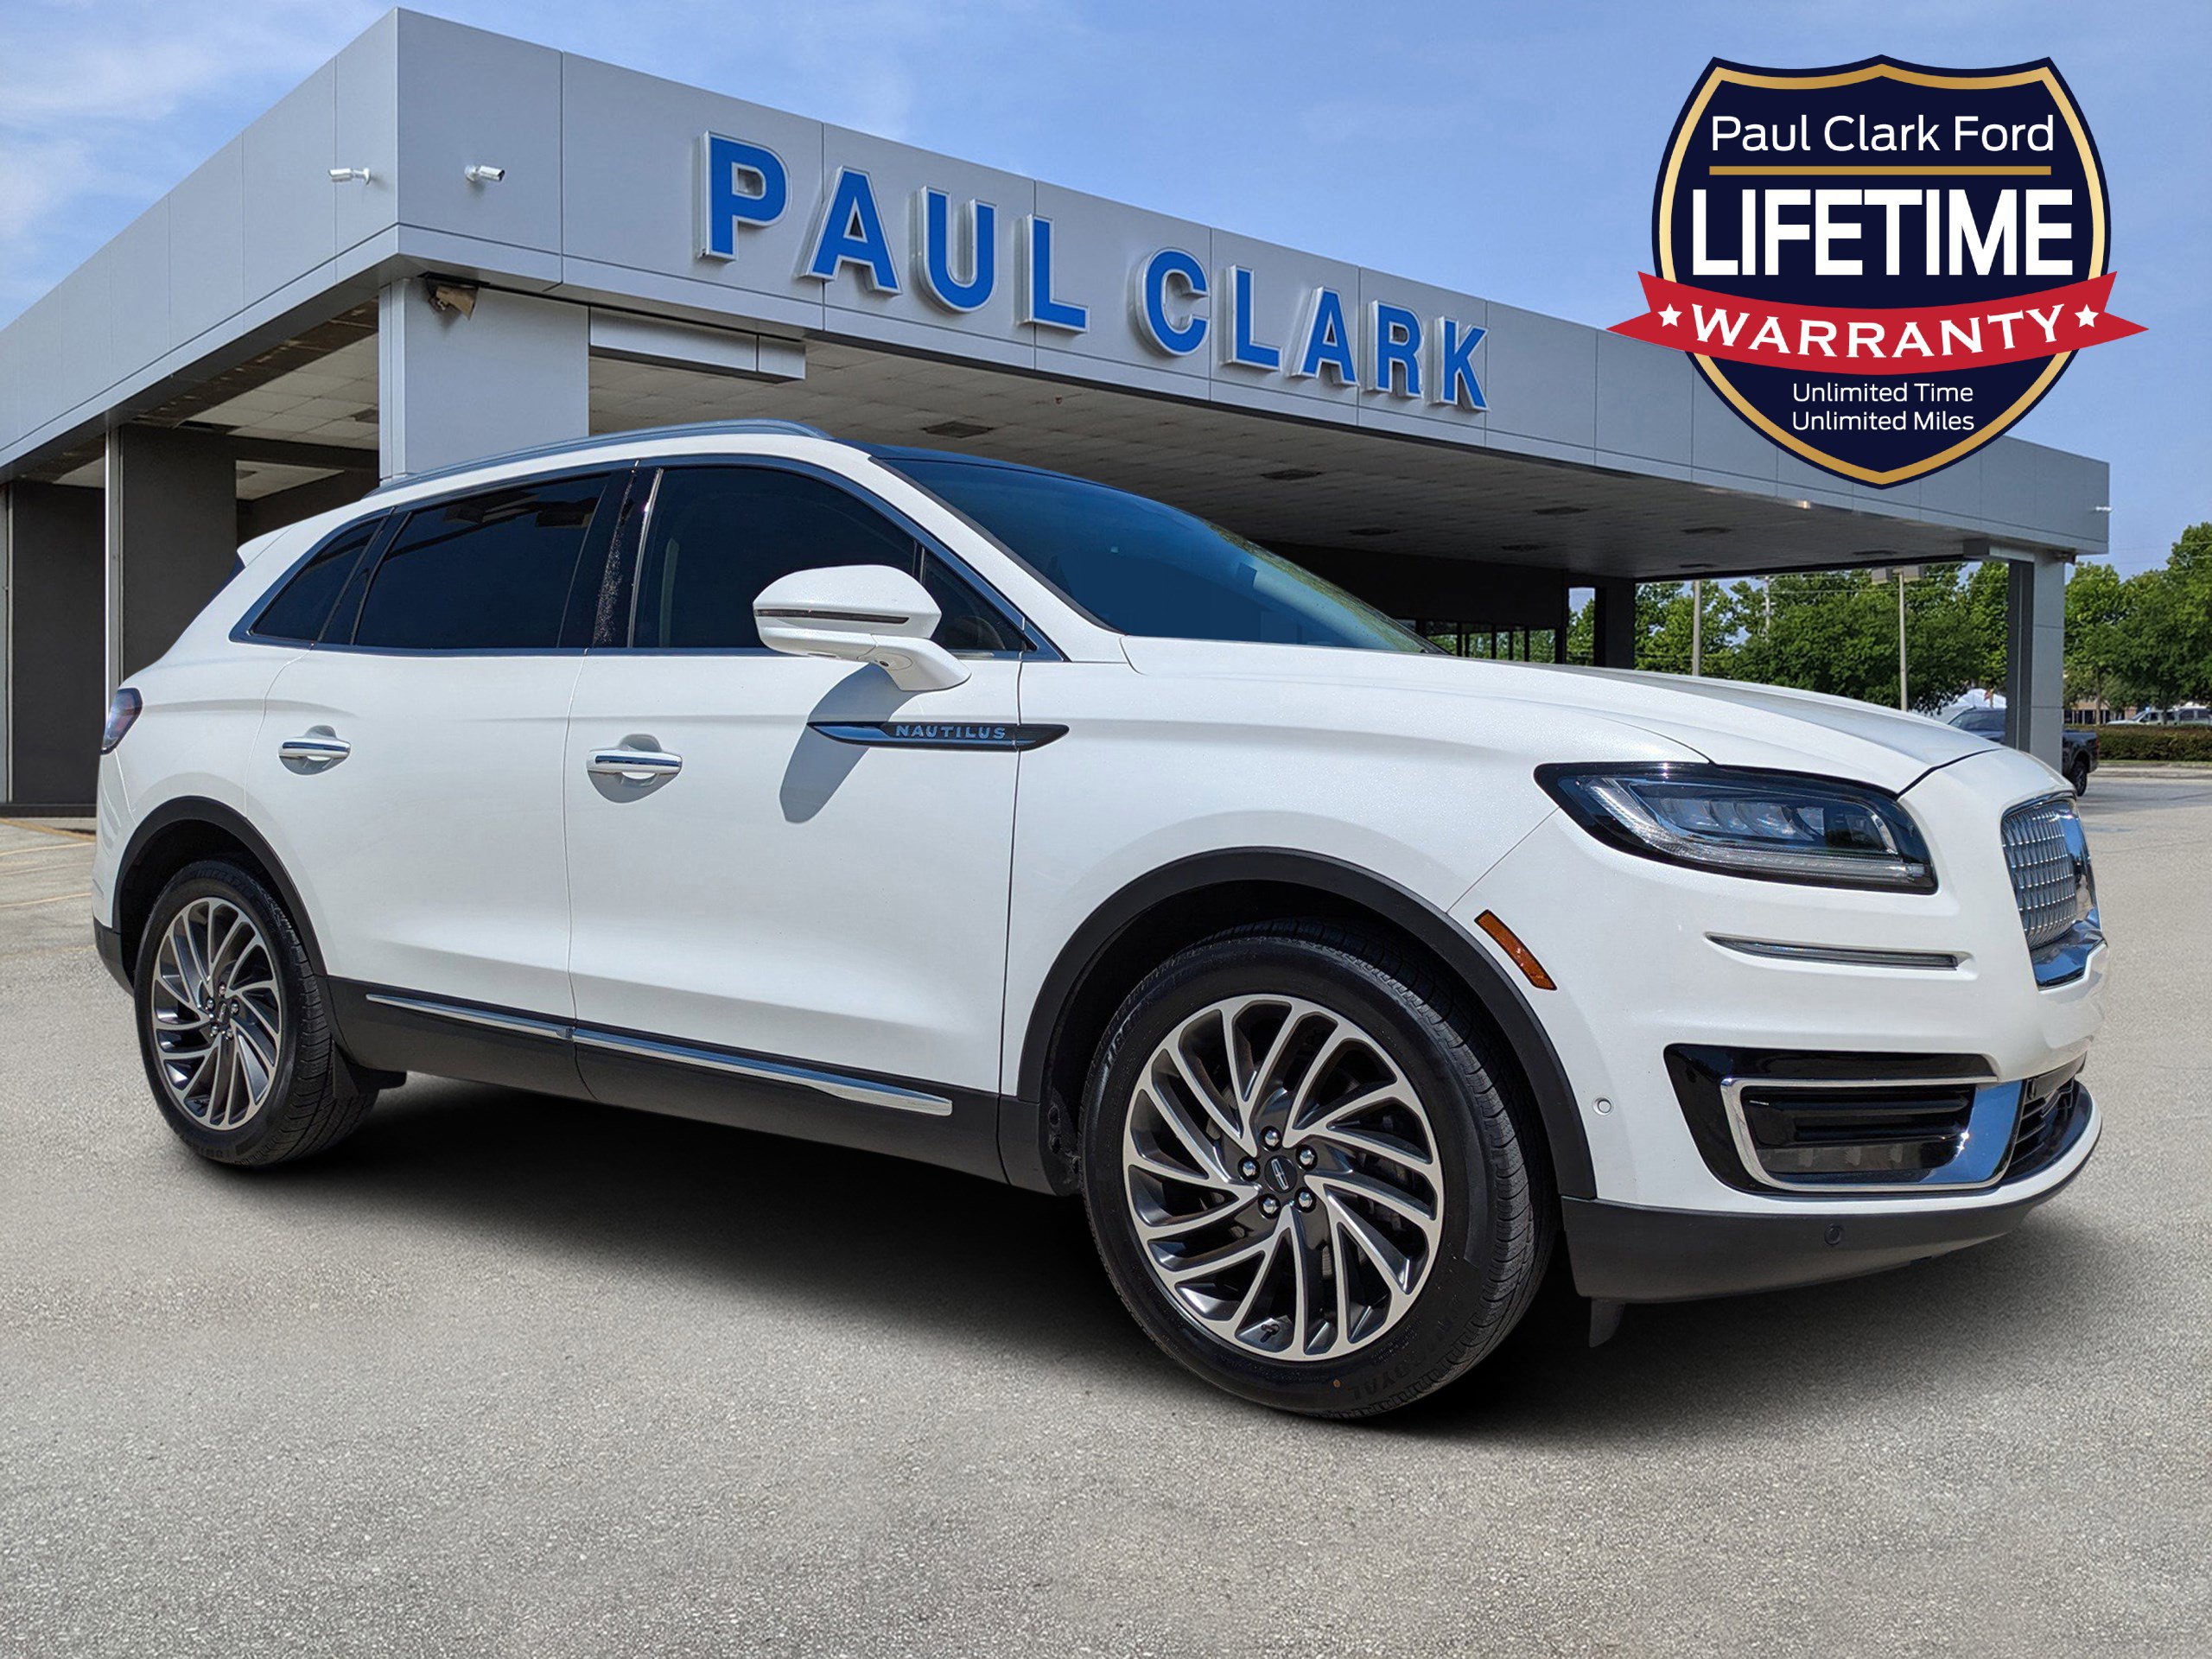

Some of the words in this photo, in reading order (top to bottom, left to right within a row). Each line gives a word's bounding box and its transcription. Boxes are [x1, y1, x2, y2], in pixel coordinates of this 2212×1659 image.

[702, 132, 1088, 332] PAUL
[1137, 248, 1489, 411] CLARK
[895, 724, 1006, 740] NAUTILUS
